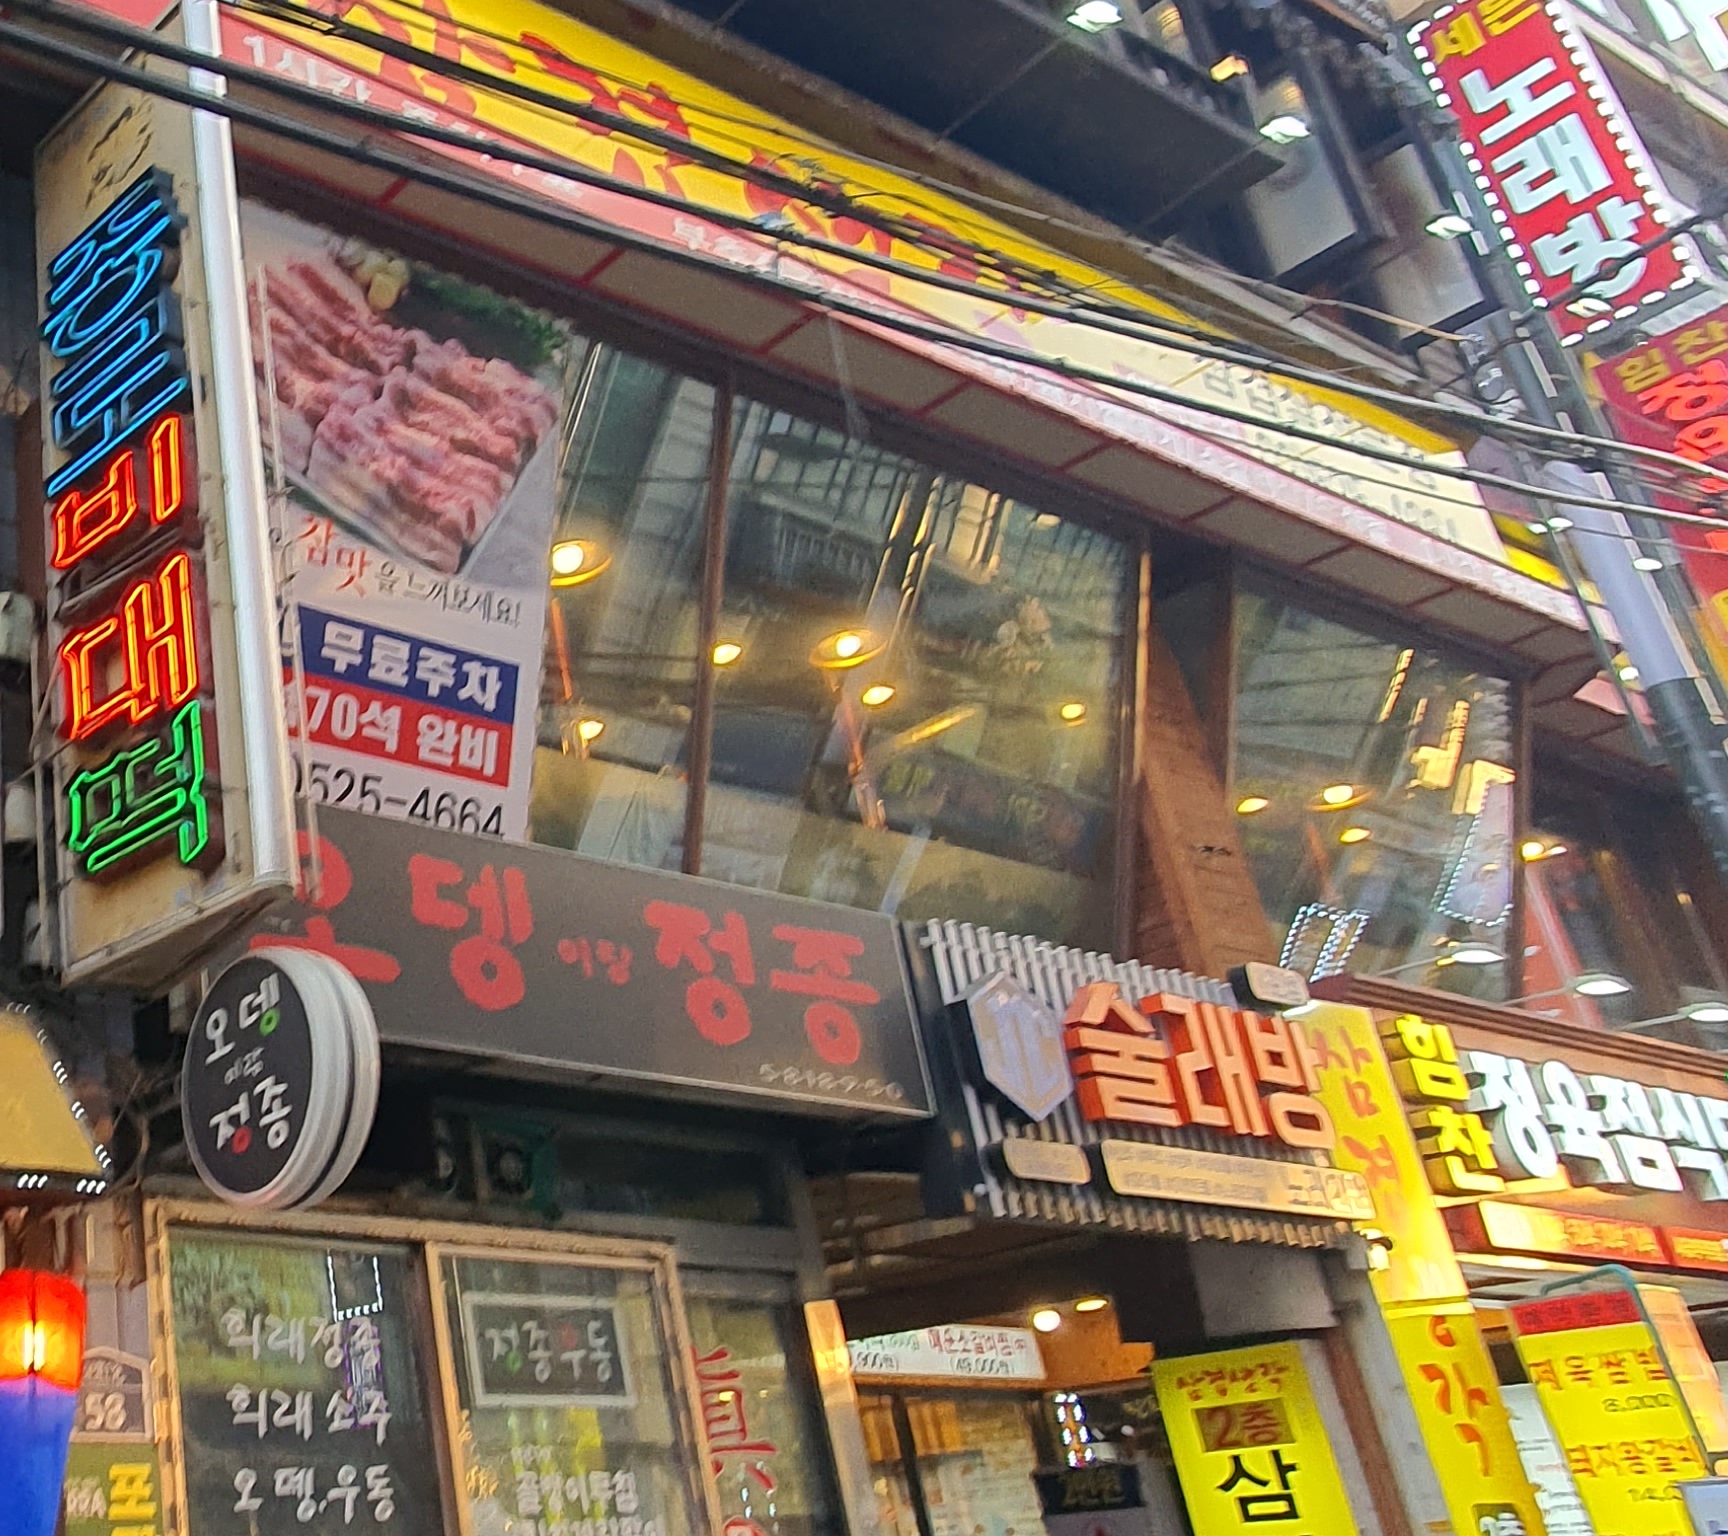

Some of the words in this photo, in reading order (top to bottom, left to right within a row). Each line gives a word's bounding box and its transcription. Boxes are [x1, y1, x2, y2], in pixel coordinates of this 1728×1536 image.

[1458, 54, 1650, 302] 노래방
[321, 620, 504, 714] 무료주차
[417, 714, 500, 778] 완비
[206, 972, 280, 1066] 오뎅
[643, 900, 880, 1066] 정종
[1064, 980, 1336, 1150] 술래방
[208, 1074, 294, 1156] 정종
[1204, 1404, 1282, 1448] 2층
